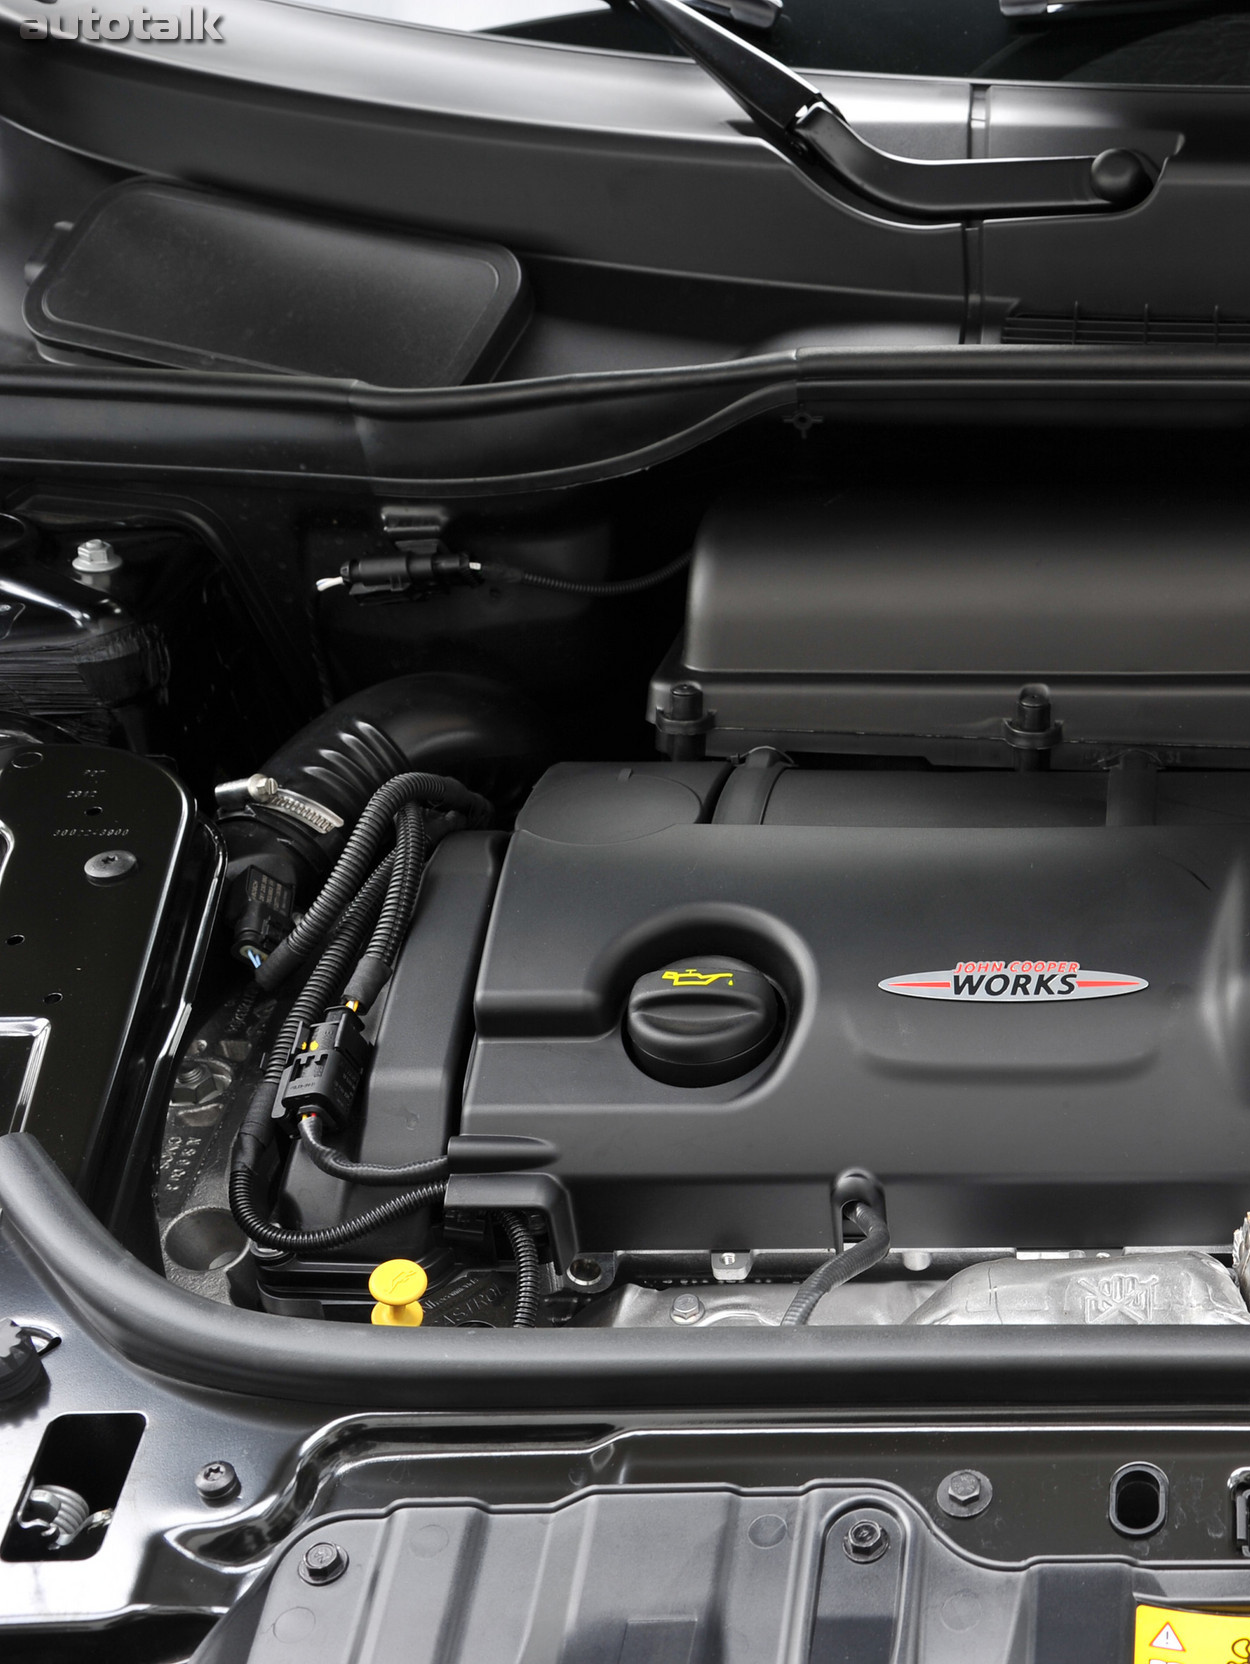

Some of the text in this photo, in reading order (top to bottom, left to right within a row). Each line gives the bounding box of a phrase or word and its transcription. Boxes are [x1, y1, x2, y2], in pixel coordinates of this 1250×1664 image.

[954, 961, 1079, 974] JOHN COOPER
[952, 973, 1078, 996] WORKS
